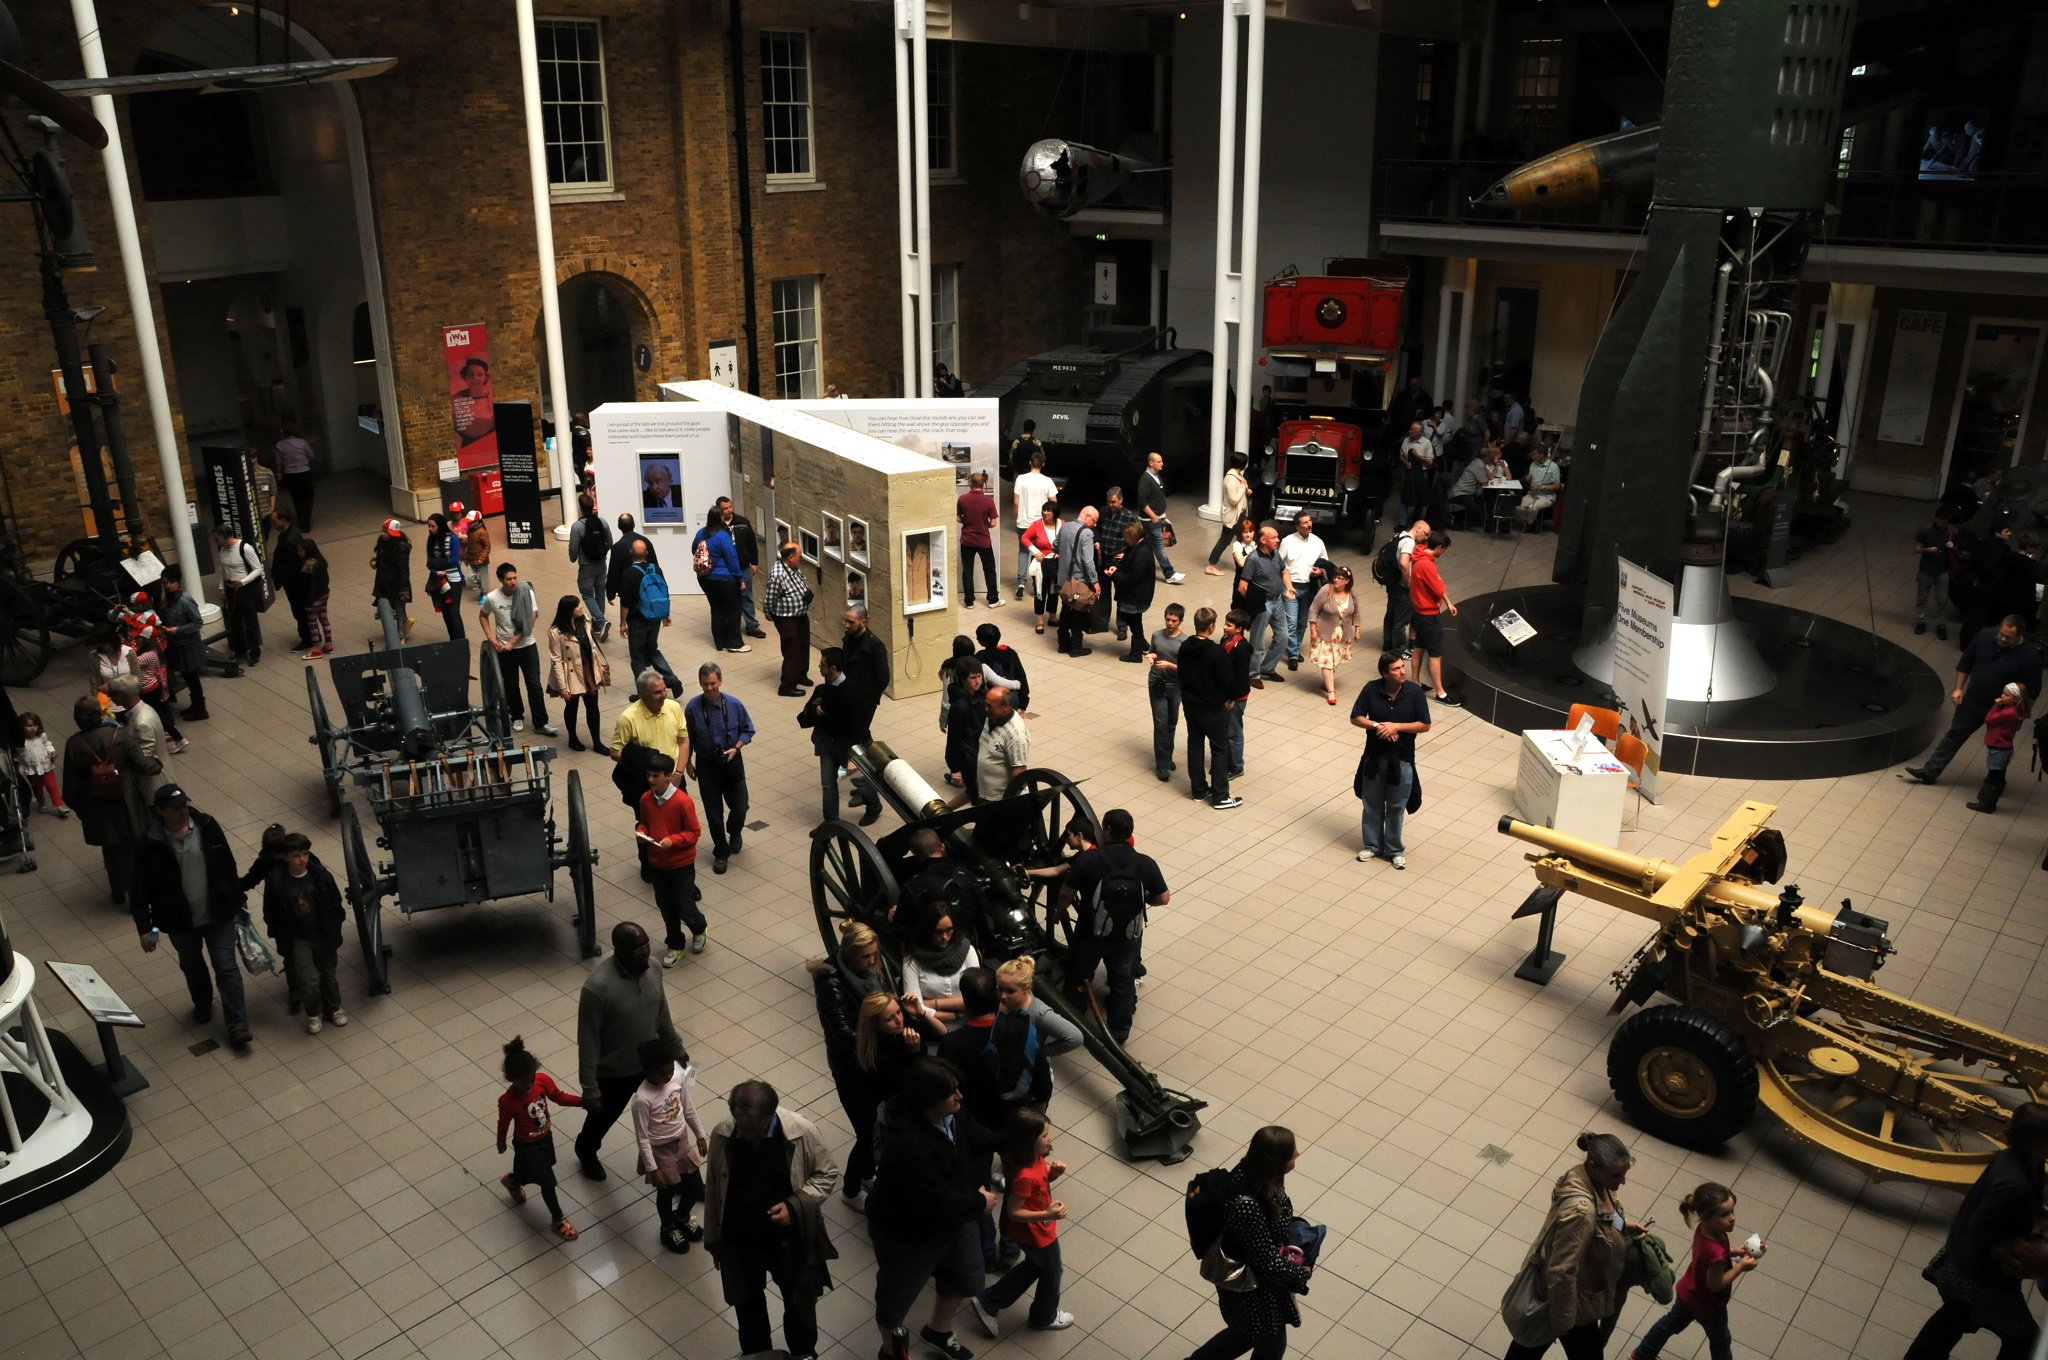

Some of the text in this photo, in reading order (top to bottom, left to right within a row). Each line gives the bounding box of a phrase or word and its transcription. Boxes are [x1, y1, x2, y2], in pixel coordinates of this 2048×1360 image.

[450, 333, 467, 343] IWM
[214, 465, 228, 505] HEROES
[1305, 488, 1326, 496] 4743
[227, 486, 239, 515] GALLERY
[1617, 614, 1629, 626] One
[1630, 619, 1664, 649] Membership
[1619, 602, 1657, 632] Five Museums
